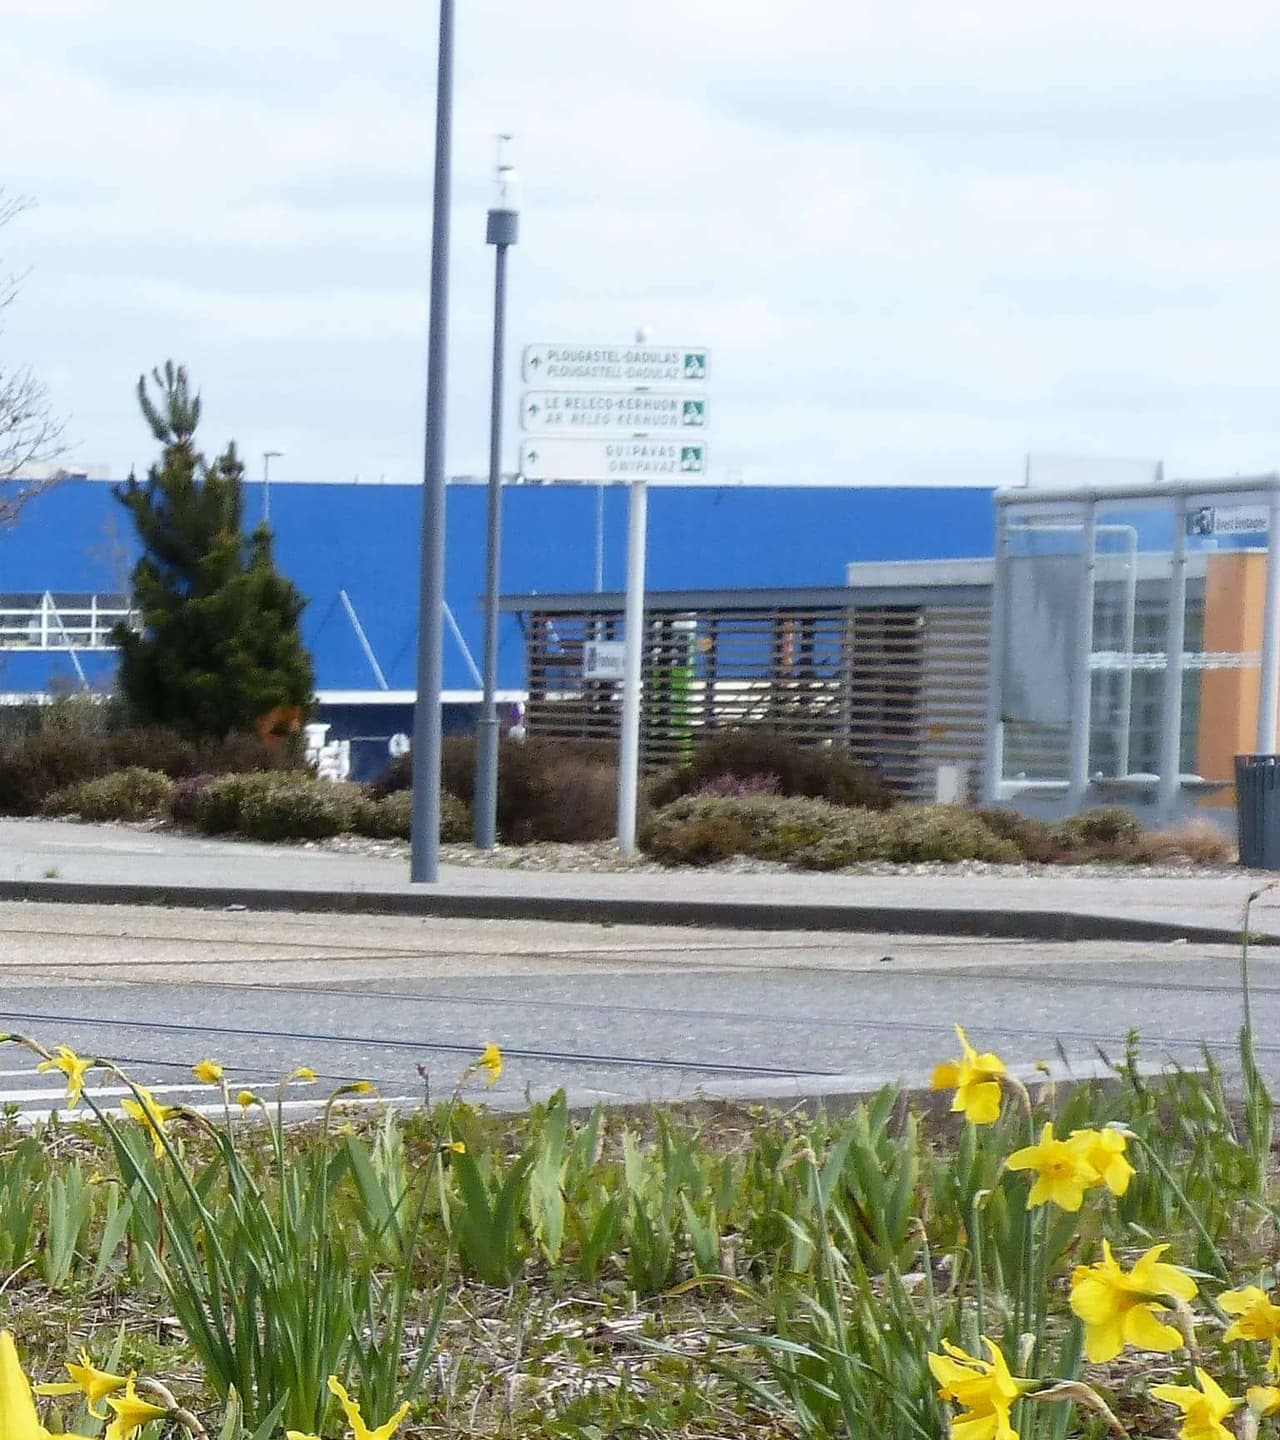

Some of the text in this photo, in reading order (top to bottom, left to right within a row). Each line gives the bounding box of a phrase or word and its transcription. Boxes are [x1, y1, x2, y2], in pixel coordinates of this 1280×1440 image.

[547, 350, 680, 364] PLOUGASTEL-DAOULAS
[545, 397, 560, 409] LE
[605, 445, 677, 457] GUIPAVAS
